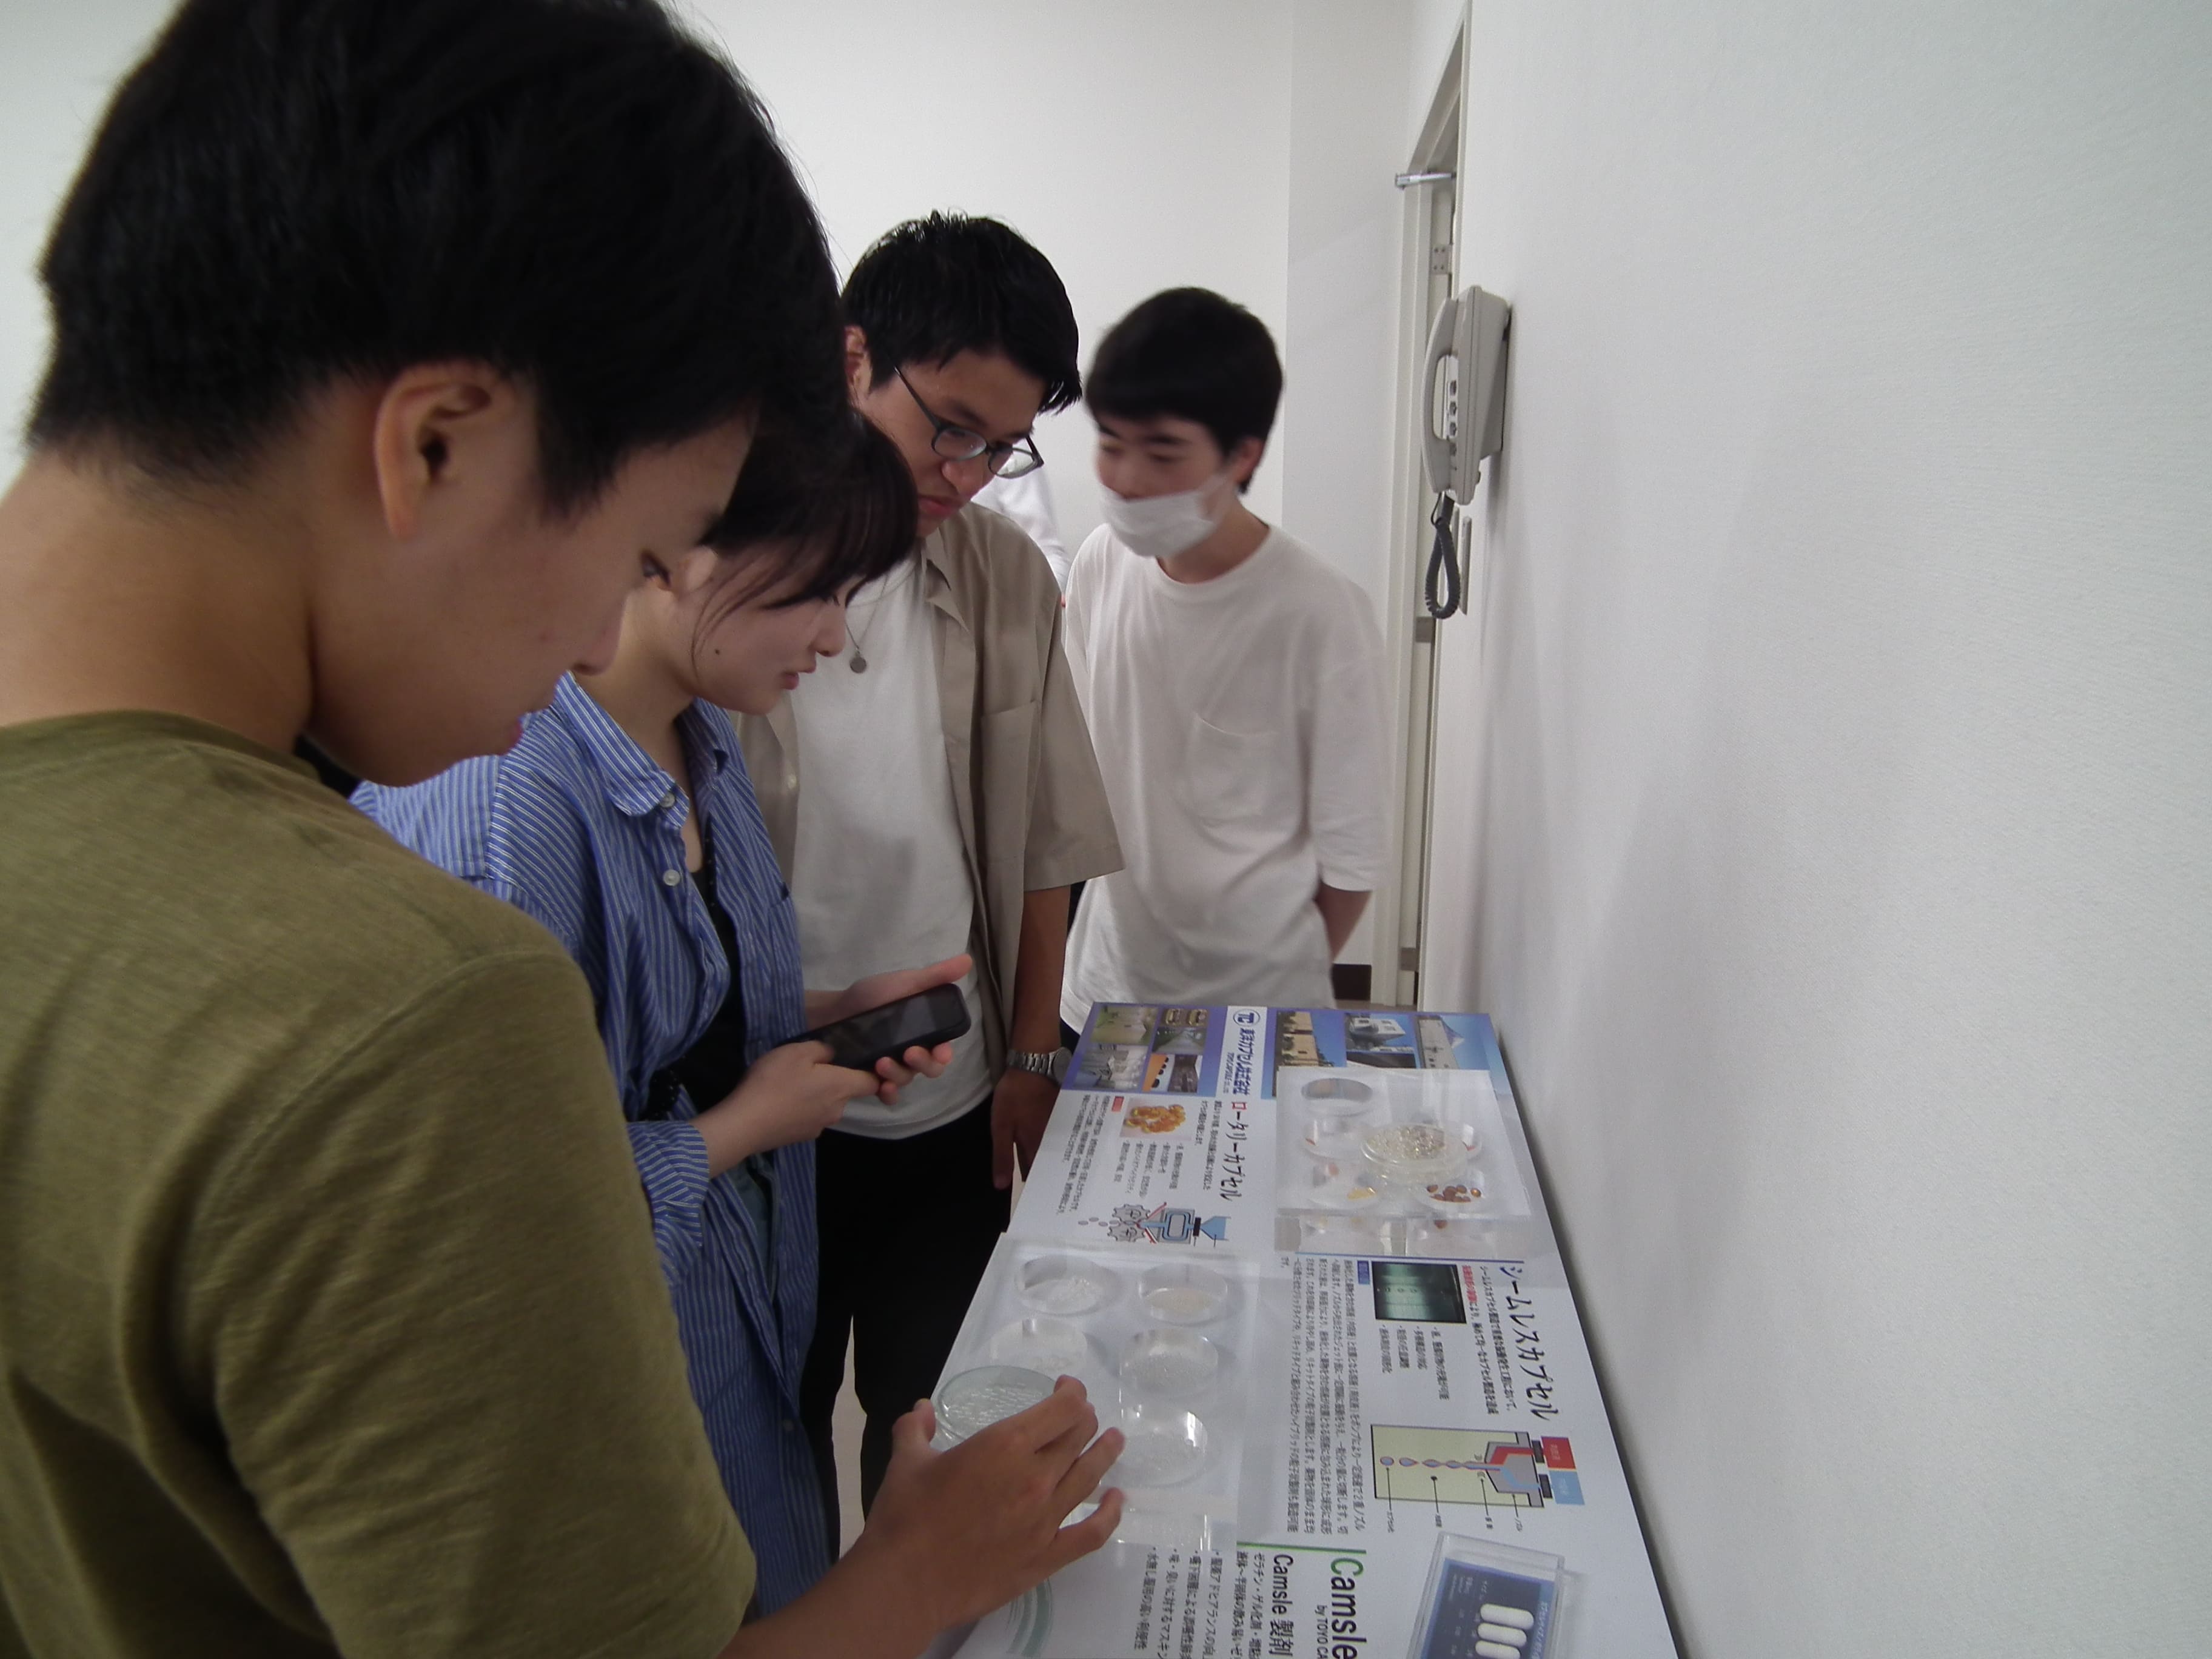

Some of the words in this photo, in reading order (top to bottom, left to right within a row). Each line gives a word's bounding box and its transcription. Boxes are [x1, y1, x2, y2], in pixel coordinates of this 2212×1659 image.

[1219, 1101, 1248, 1202] ロータリーカプセル
[1500, 1266, 1559, 1421] シームレスカプセル
[1272, 1554, 1294, 1615] Camsle
[1315, 1604, 1328, 1616] by
[1330, 1558, 1367, 1659] Camsle
[1269, 1619, 1295, 1657] 製剤
[1316, 1618, 1329, 1644] TOYO
